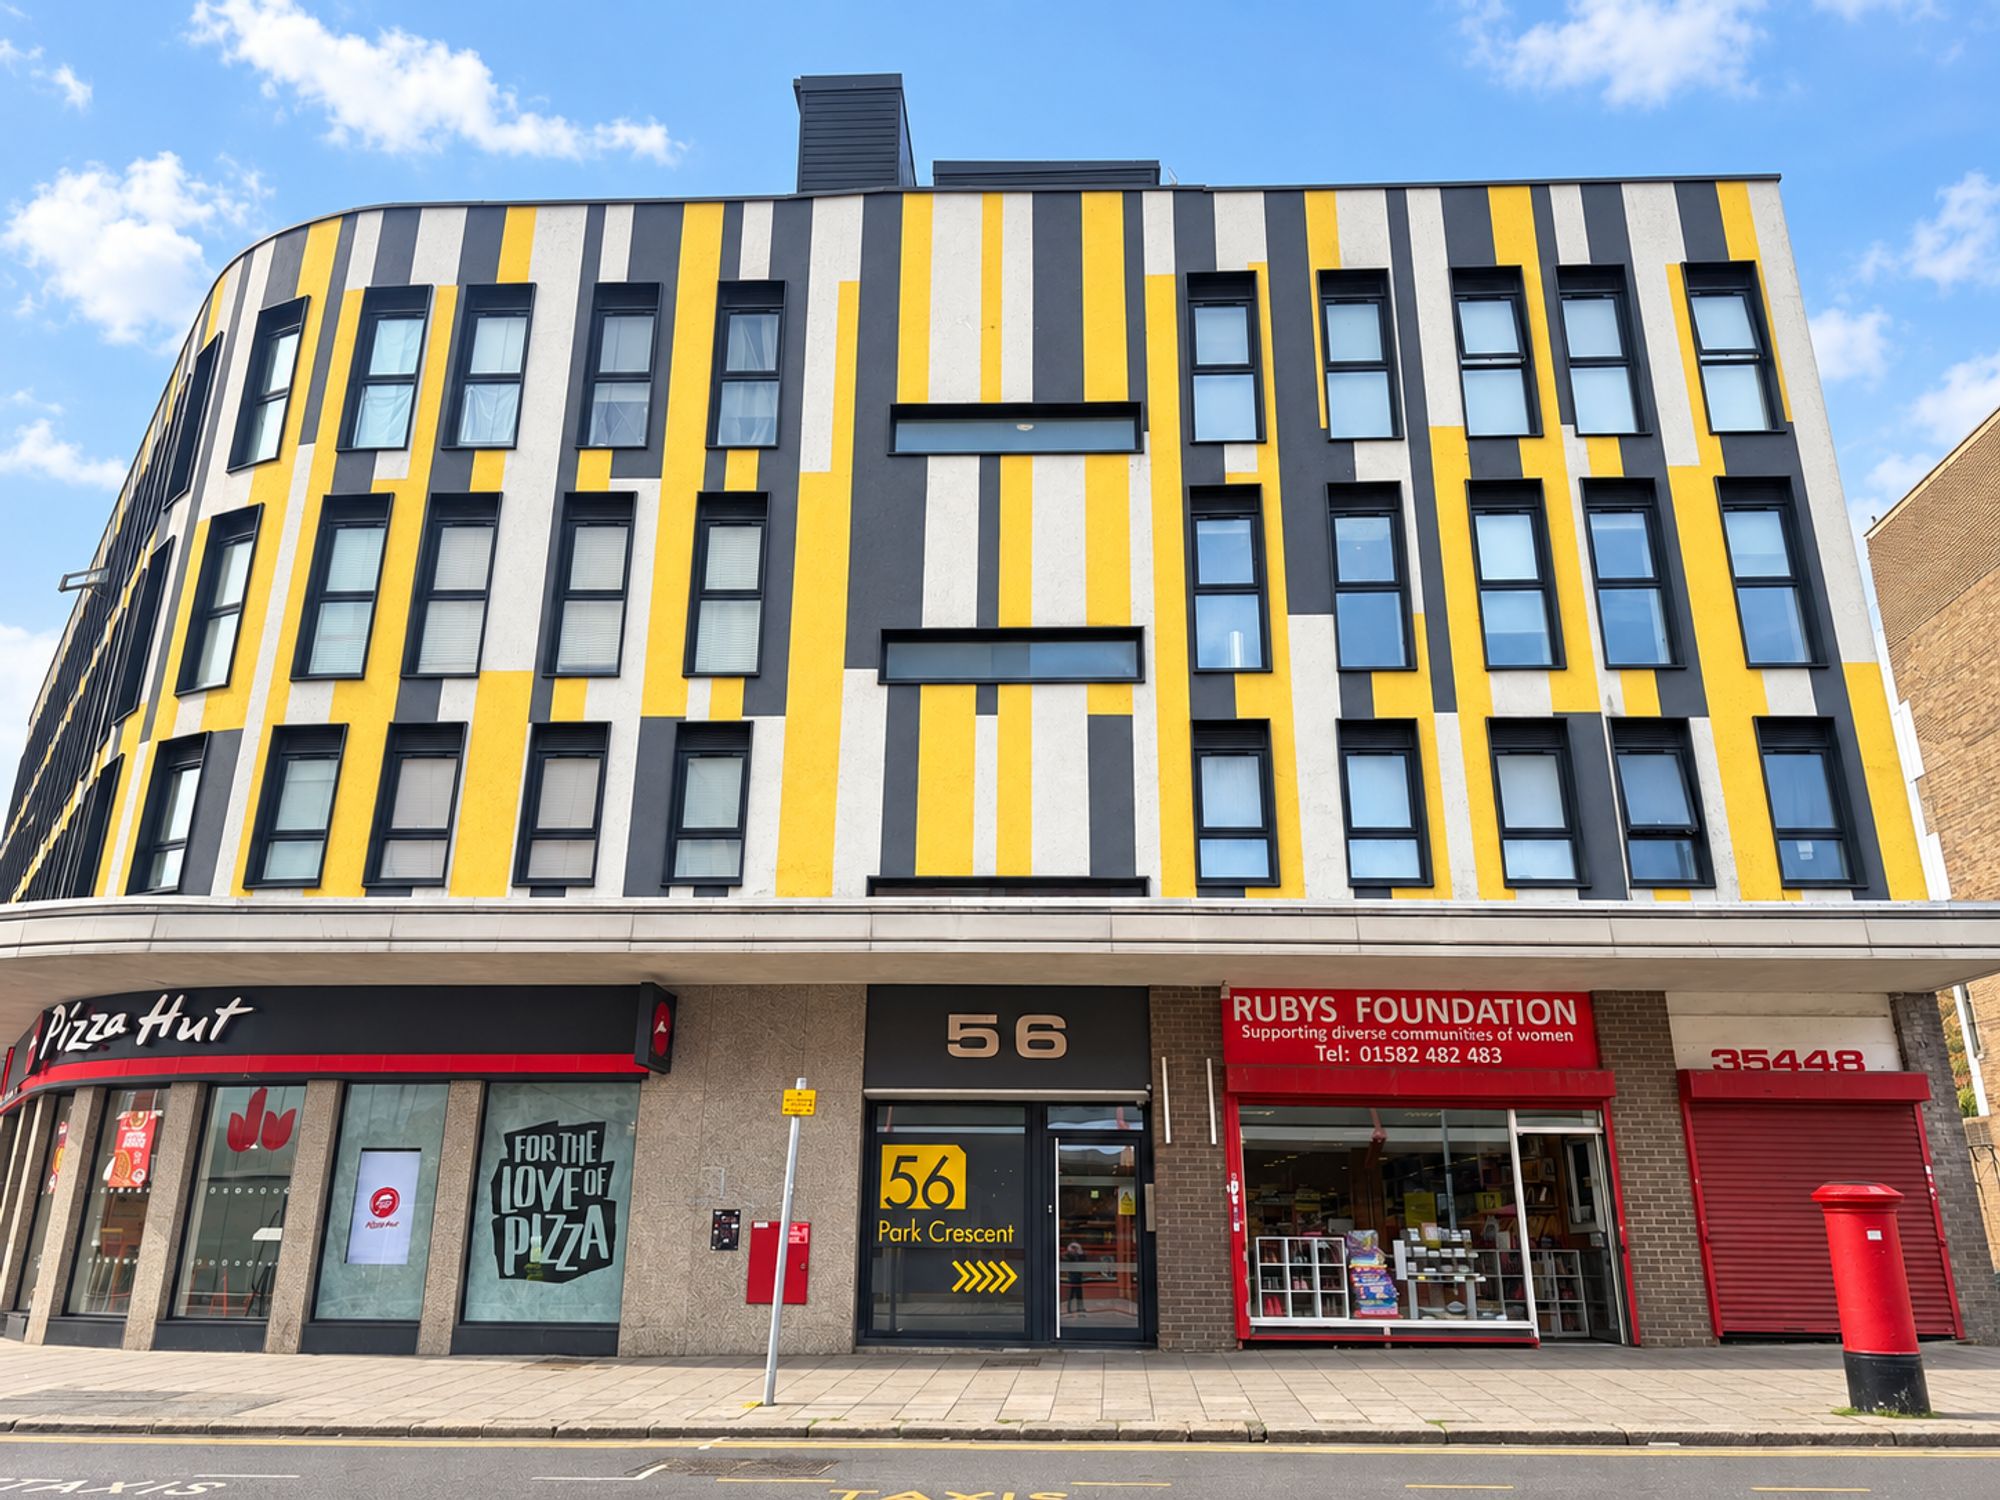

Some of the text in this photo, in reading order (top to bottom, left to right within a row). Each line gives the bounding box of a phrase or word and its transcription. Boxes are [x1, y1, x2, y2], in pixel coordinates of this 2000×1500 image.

[39, 994, 254, 1060] Pizza Hut
[1233, 996, 1577, 1026] RUBYS FOUNDATION
[947, 1014, 1067, 1059] 56
[1241, 1024, 1574, 1043] Supporting diverse communities of women
[1314, 1044, 1503, 1064] Tel: 01582 482 483
[1711, 1048, 1866, 1072] 35448
[514, 1130, 598, 1166] FOR THE
[502, 1165, 607, 1214] LOVE OF
[884, 1154, 955, 1209] 56
[503, 1204, 609, 1276] PIZZA
[878, 1217, 1015, 1244] Park Crescent
[0, 1479, 227, 1495] TAXIS
